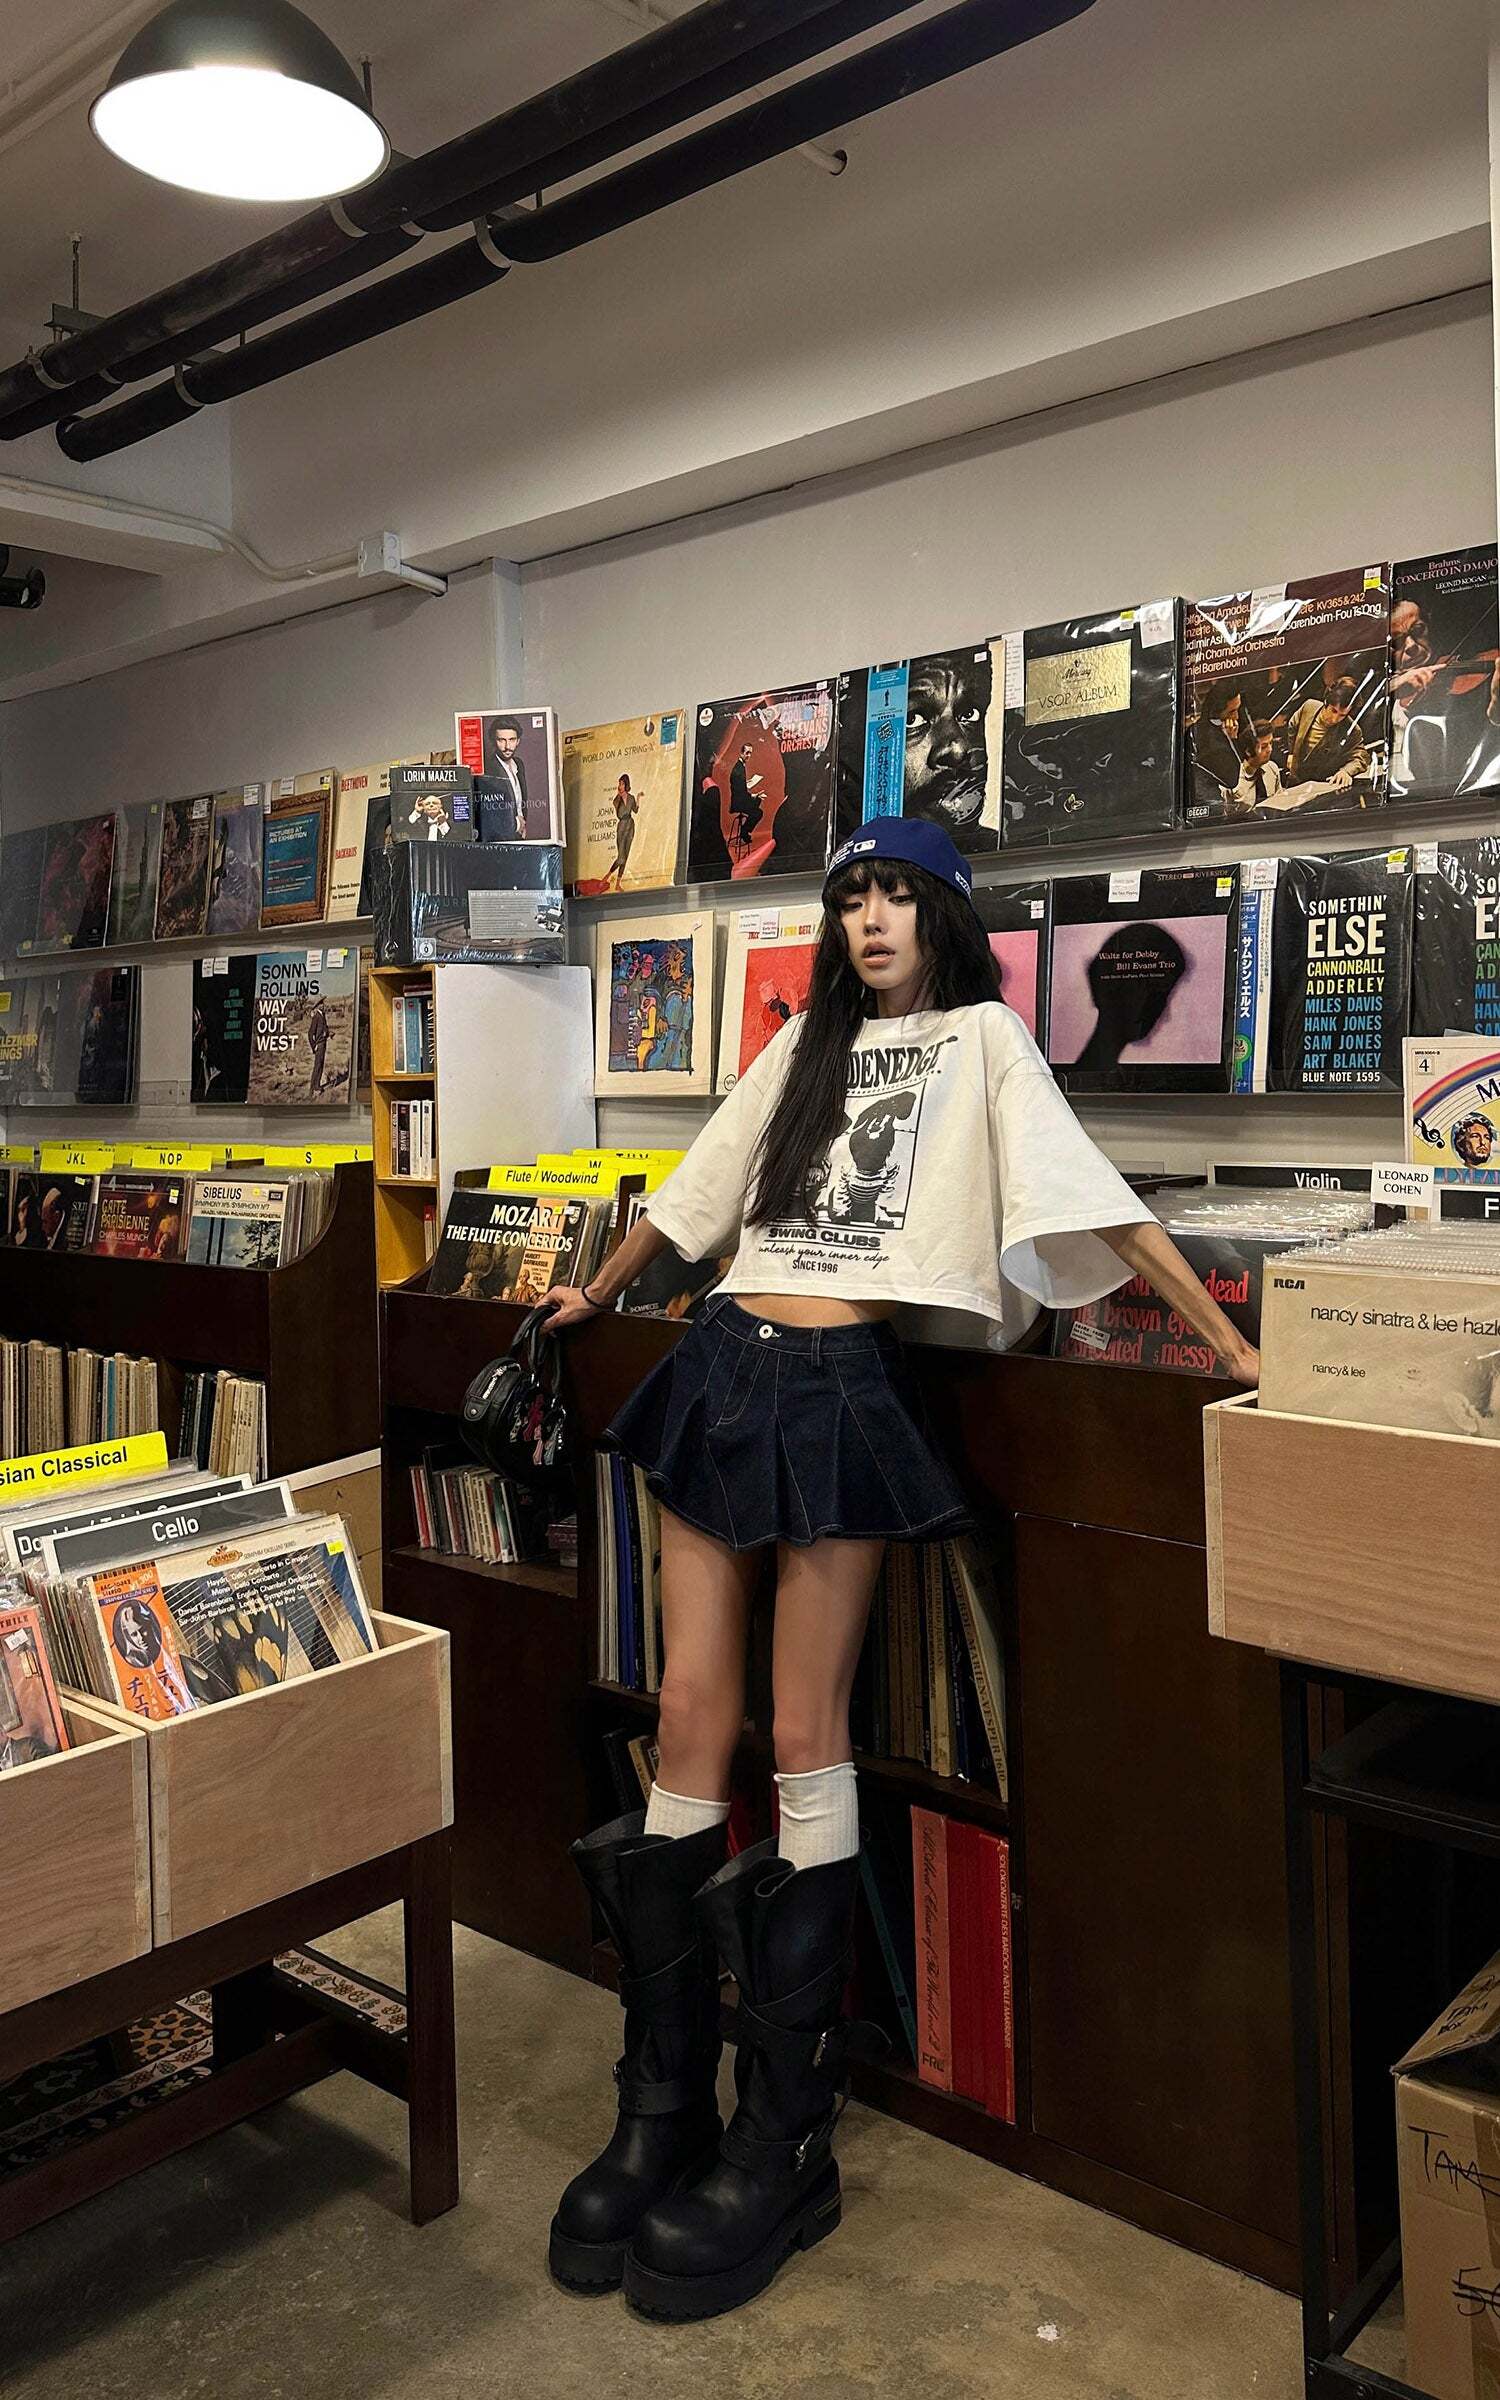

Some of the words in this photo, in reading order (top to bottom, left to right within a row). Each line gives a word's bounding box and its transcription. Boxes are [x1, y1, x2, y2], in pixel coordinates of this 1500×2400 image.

[1395, 567, 1449, 585] CONCERTO
[1450, 565, 1461, 575] IN
[1244, 637, 1285, 652] Orchestra
[1038, 693, 1071, 708] VSOP
[1075, 685, 1118, 703] ALBUM
[403, 770, 426, 782] LORIN
[428, 770, 458, 782] MAAZEL
[1308, 894, 1388, 917] SOMETHIN'
[1475, 897, 1500, 940] E
[1307, 913, 1387, 959] ELSE
[1099, 951, 1120, 960] Waltz
[1122, 951, 1134, 959] for
[1135, 950, 1159, 959] Debby
[261, 963, 308, 981] SONNY
[1116, 962, 1131, 971] Bill
[1132, 961, 1157, 970] Evans
[1158, 961, 1176, 969] Trio
[1306, 958, 1385, 978] CANNONBALL
[1239, 935, 1254, 1018] サムシン・エルス
[260, 980, 320, 998] ROLLINS
[1306, 976, 1385, 996] ADDERLEY
[259, 999, 288, 1016] WAY
[1304, 996, 1342, 1014] MILES
[1347, 995, 1383, 1013] DAVIS
[257, 1017, 288, 1034] OUT
[1304, 1016, 1337, 1033] HANK
[1342, 1015, 1382, 1032] JONES
[257, 1035, 299, 1051] WEST
[1303, 1036, 1332, 1051] SAM
[1338, 1033, 1382, 1051] JONES
[1303, 1055, 1327, 1070] ART
[1333, 1053, 1382, 1070] BLAKEY
[1418, 1058, 1430, 1073] 4
[1302, 1072, 1325, 1083] BLUE
[1329, 1072, 1352, 1083] NOTE
[1356, 1071, 1381, 1083] 1595
[1476, 1077, 1500, 1103] M
[66, 1154, 87, 1166] JKL
[159, 1153, 184, 1166] NOP
[305, 1151, 312, 1164] S
[505, 1169, 532, 1182] Flute
[540, 1170, 599, 1184] Woodwind
[1294, 1172, 1341, 1191] Violin
[1378, 1170, 1429, 1183] LEONARD
[203, 1186, 242, 1200] SIBELIUS
[1383, 1183, 1422, 1195] COHEN
[100, 1214, 150, 1231] PARISIENNE
[490, 1204, 565, 1229] MOZART
[446, 1224, 467, 1241] THE
[467, 1226, 501, 1245] FLUTE
[501, 1230, 574, 1253] CONCERTOS
[768, 1227, 817, 1240] SWING
[820, 1230, 881, 1248] CLUBS
[758, 1243, 796, 1256] unleash
[828, 1251, 862, 1261] inner
[863, 1251, 890, 1270] edge
[792, 1259, 817, 1270] SINCE
[1203, 1268, 1249, 1304] dead
[1273, 1278, 1305, 1290] RCA
[1104, 1298, 1161, 1333] brown
[1310, 1305, 1359, 1326] nancy
[1362, 1308, 1415, 1329] sinatra
[1417, 1314, 1430, 1331] &
[1432, 1313, 1458, 1333] lee
[1160, 1343, 1217, 1374] messy
[41, 1446, 128, 1477] Classical
[151, 1515, 200, 1544] Cello
